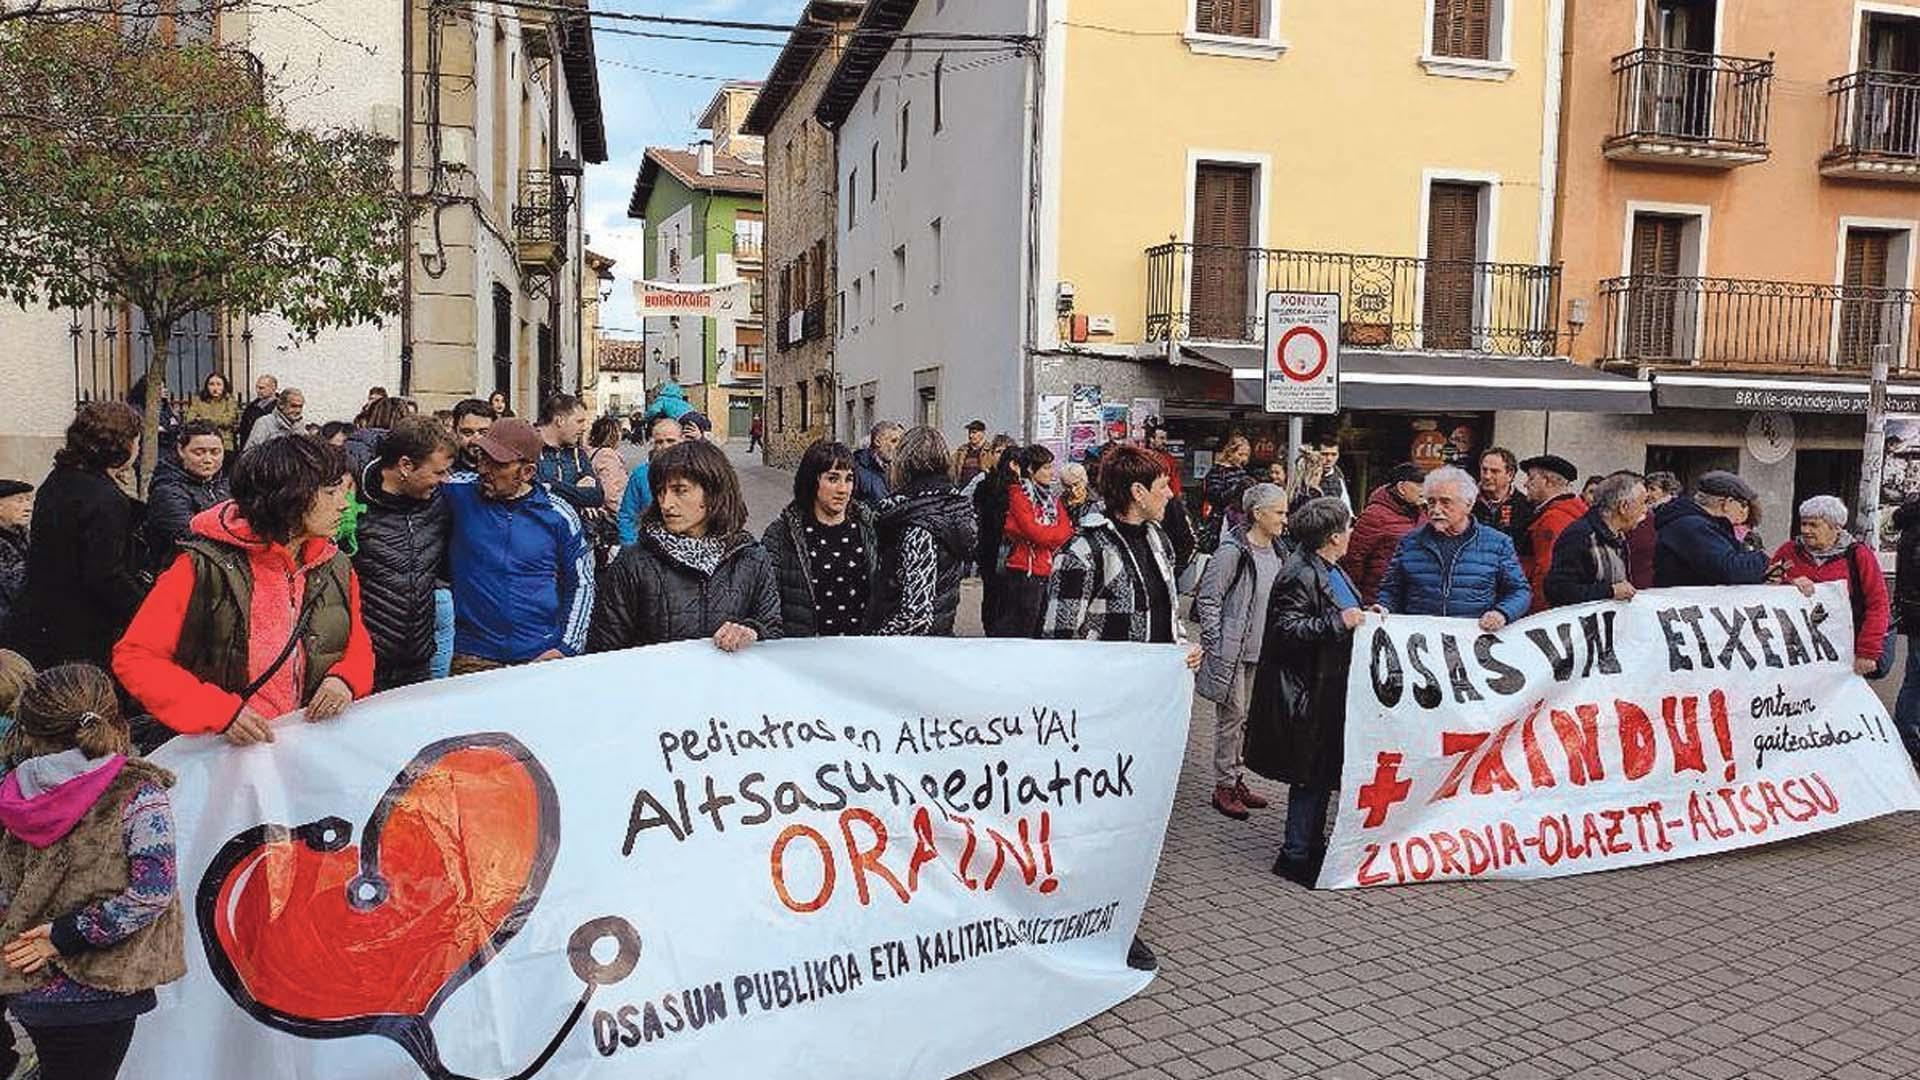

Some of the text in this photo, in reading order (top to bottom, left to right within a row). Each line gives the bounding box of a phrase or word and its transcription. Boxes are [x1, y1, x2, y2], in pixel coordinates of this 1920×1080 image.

[1280, 295, 1328, 308] KONTUZ
[1735, 390, 1762, 406] B&K
[1655, 602, 1840, 673] ETXEAK
[659, 706, 1080, 772] pediatras en Altsasu YA!
[621, 753, 1135, 857] Altsasun pediatrak
[769, 807, 1060, 913] ORAIN!
[591, 983, 728, 1057] OSASUN
[733, 954, 864, 1017] PUBLIKOA
[870, 940, 911, 982] ETA
